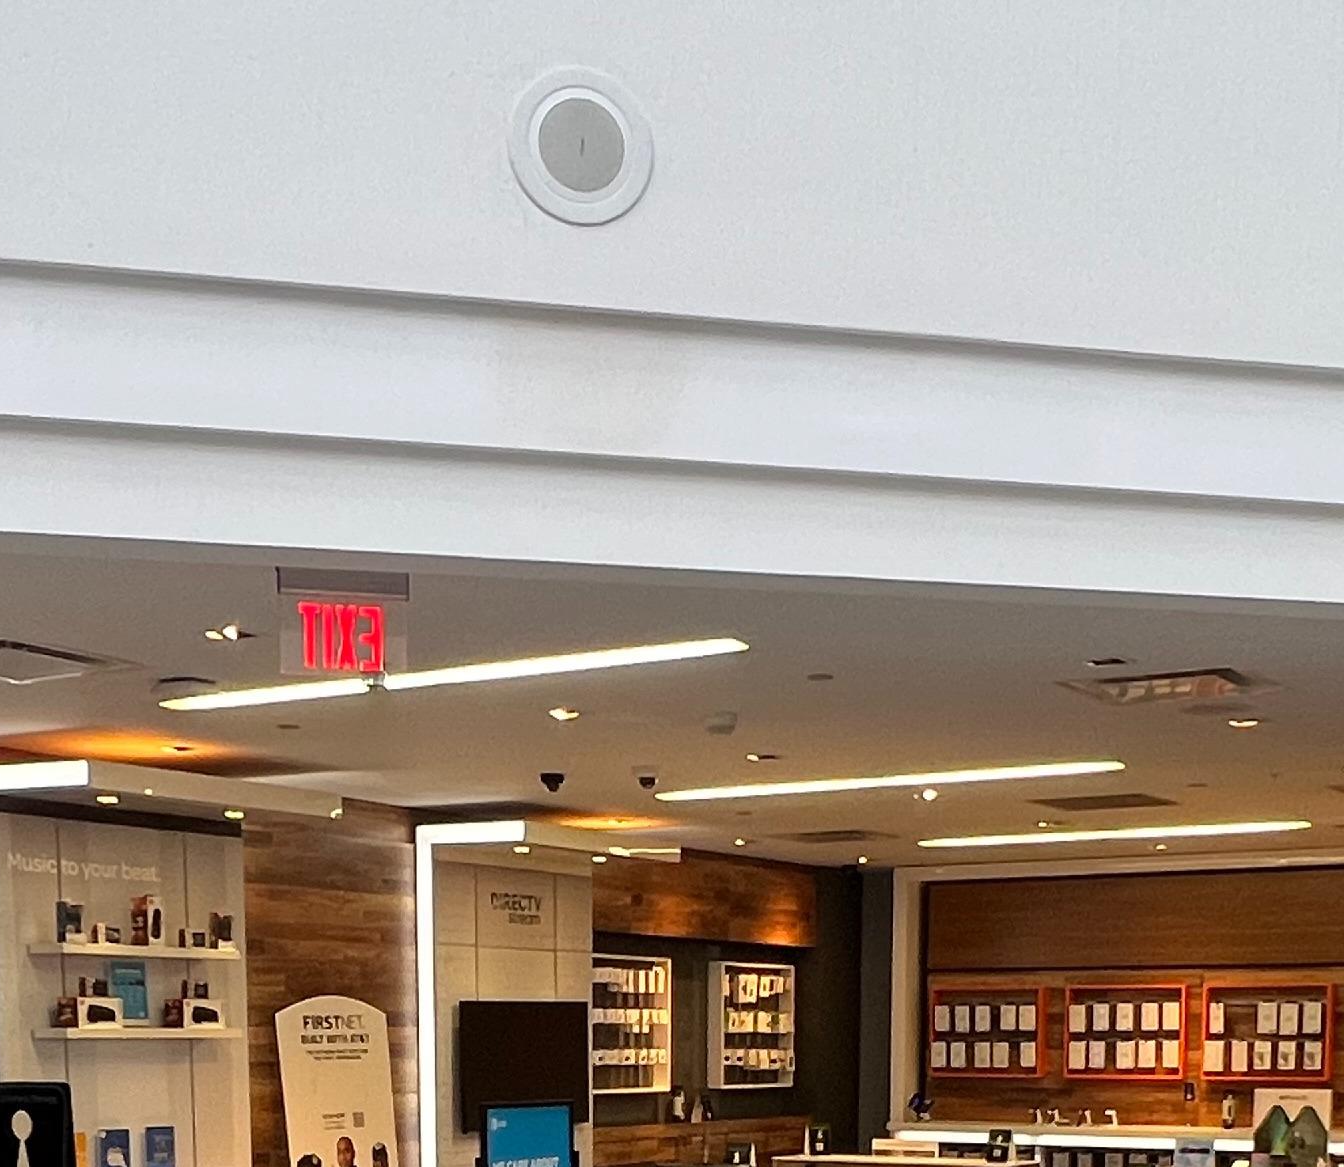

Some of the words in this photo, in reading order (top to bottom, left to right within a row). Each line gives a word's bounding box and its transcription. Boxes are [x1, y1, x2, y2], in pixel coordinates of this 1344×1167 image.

[8, 852, 57, 874] Music
[61, 858, 79, 876] to
[81, 862, 117, 880] your
